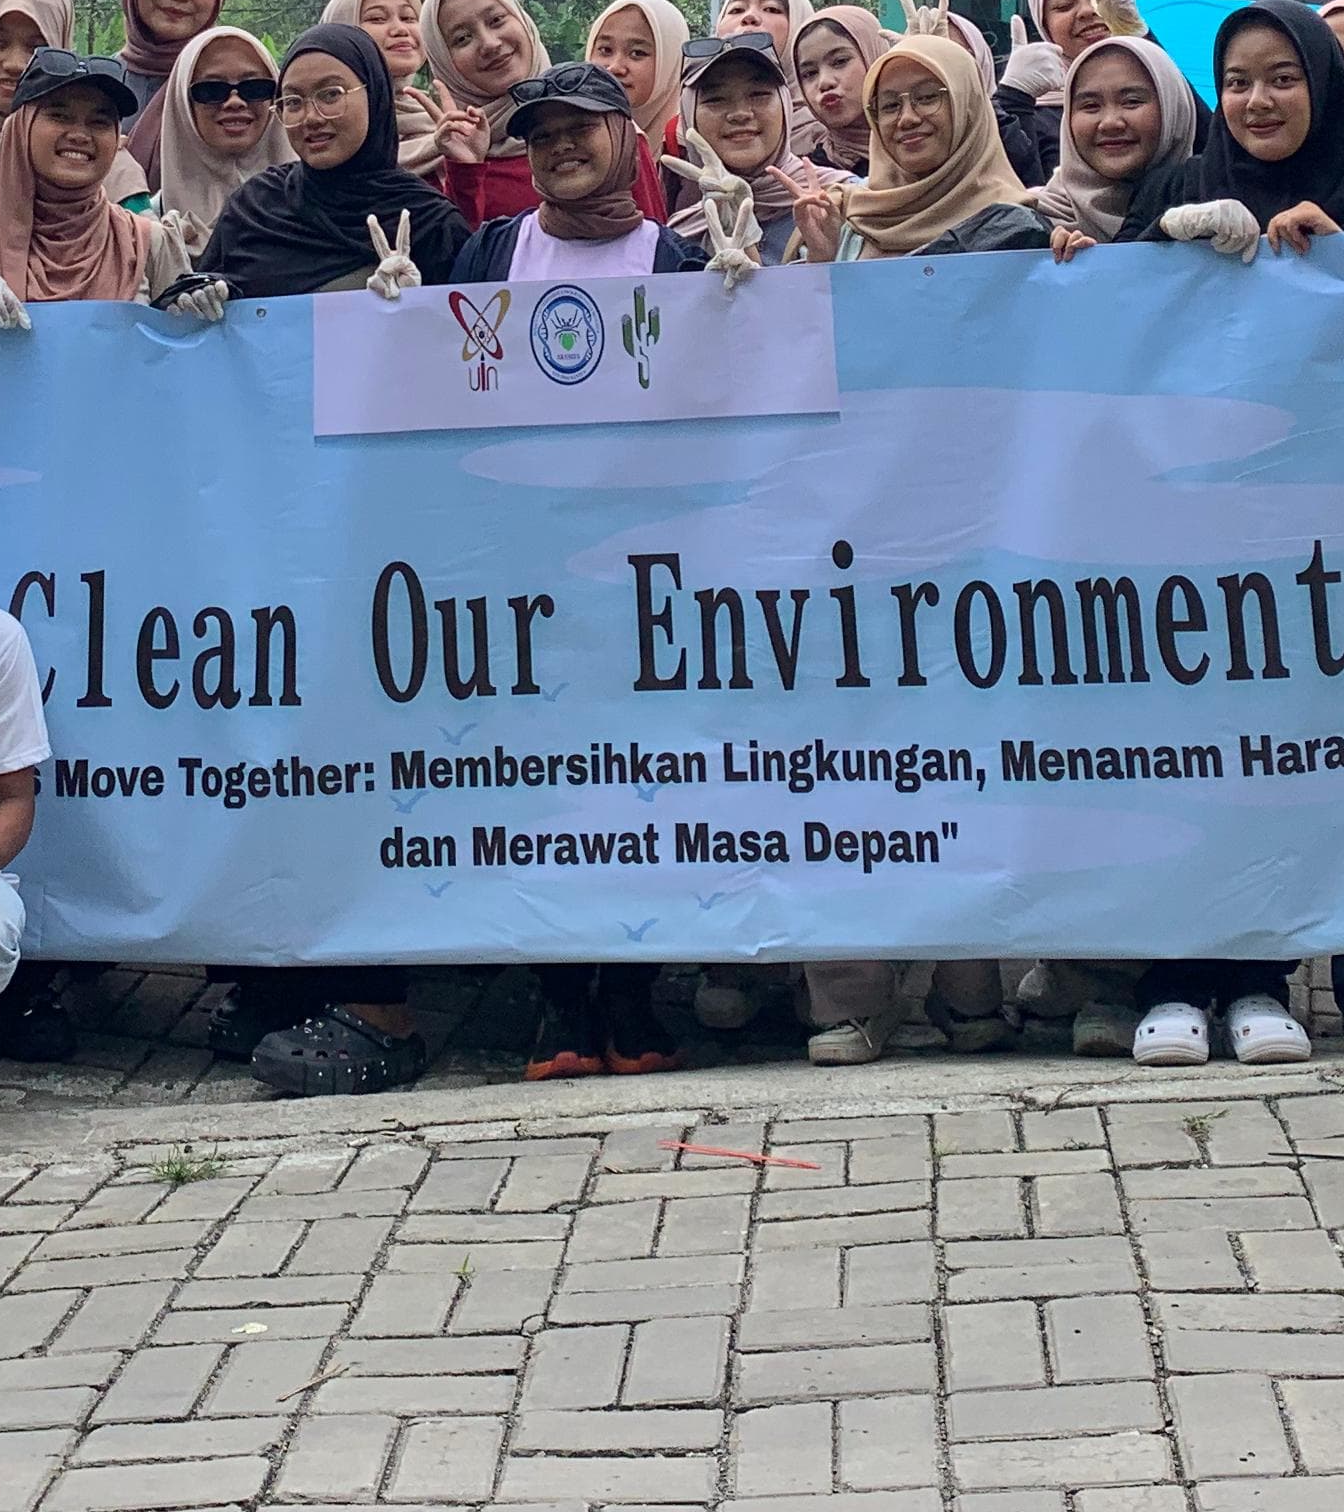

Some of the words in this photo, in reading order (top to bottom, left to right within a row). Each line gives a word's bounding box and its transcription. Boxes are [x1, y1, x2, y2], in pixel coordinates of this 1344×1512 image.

[371, 561, 555, 703] Our
[55, 759, 164, 798] Move
[178, 756, 375, 809] Together:
[390, 742, 707, 790] Membersihkan
[723, 739, 986, 793] Lingkungan,
[1001, 740, 1223, 782] Menanam
[380, 826, 457, 869] dan
[472, 823, 659, 866] Merawat
[675, 822, 790, 863] Masa
[804, 822, 958, 874] Depan"
